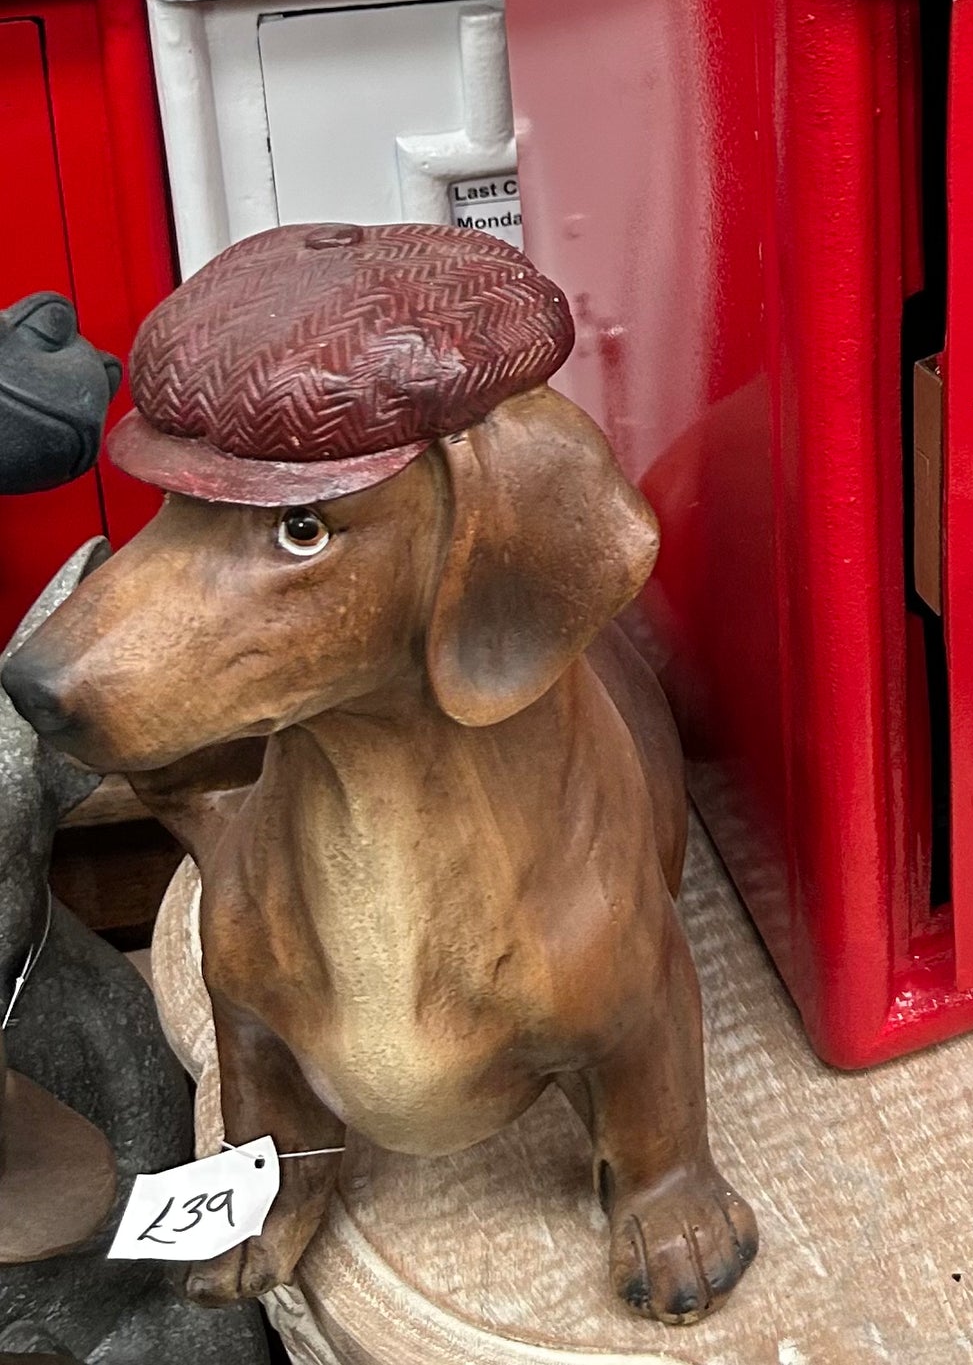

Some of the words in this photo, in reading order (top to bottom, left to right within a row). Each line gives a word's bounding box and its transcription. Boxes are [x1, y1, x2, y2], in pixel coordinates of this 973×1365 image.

[453, 183, 498, 201] Last
[457, 211, 522, 230] Monda
[137, 1189, 235, 1243] £39
